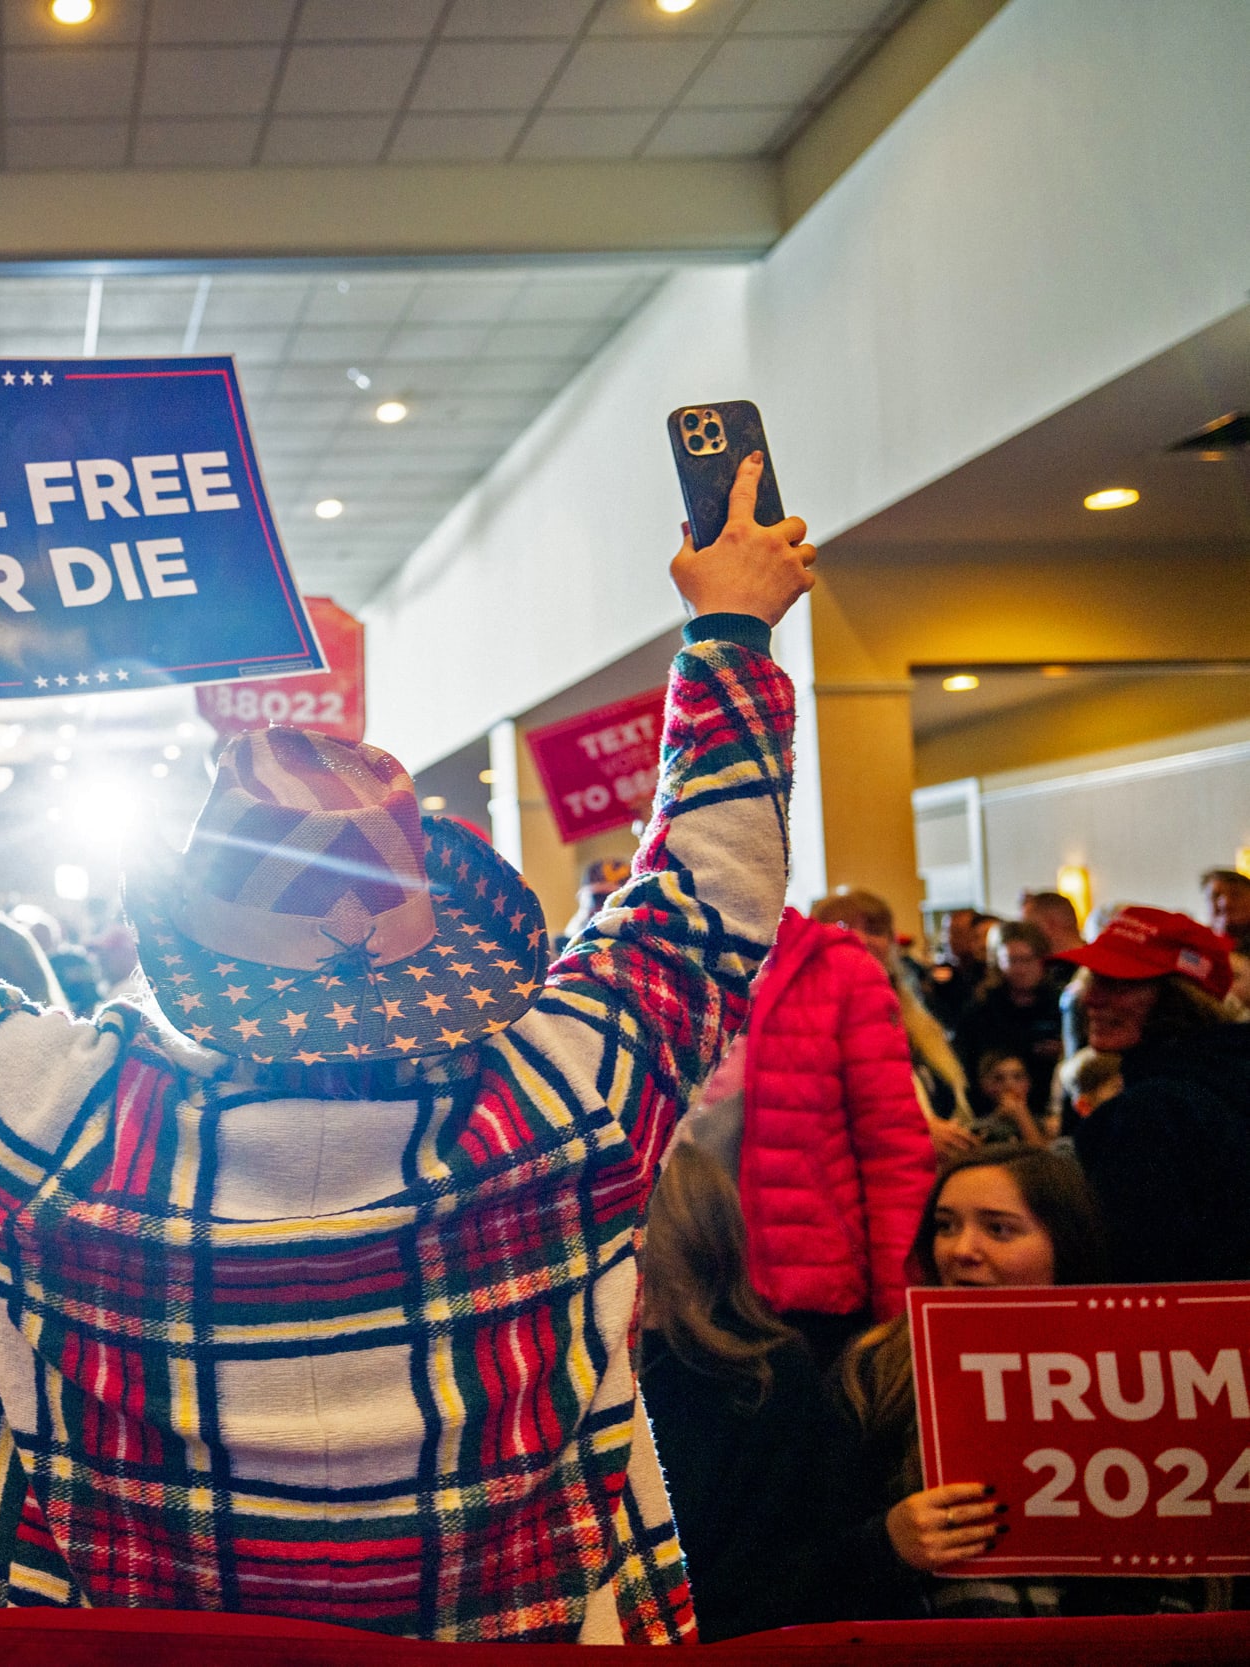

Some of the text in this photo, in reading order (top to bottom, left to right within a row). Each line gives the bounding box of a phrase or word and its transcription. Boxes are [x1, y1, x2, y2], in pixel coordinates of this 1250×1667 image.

[24, 451, 240, 525] FREE
[49, 537, 198, 608] DIE
[216, 685, 345, 724] 88022
[577, 714, 655, 759] TEXT
[562, 784, 611, 819] TO
[959, 1348, 1250, 1422] TRUM
